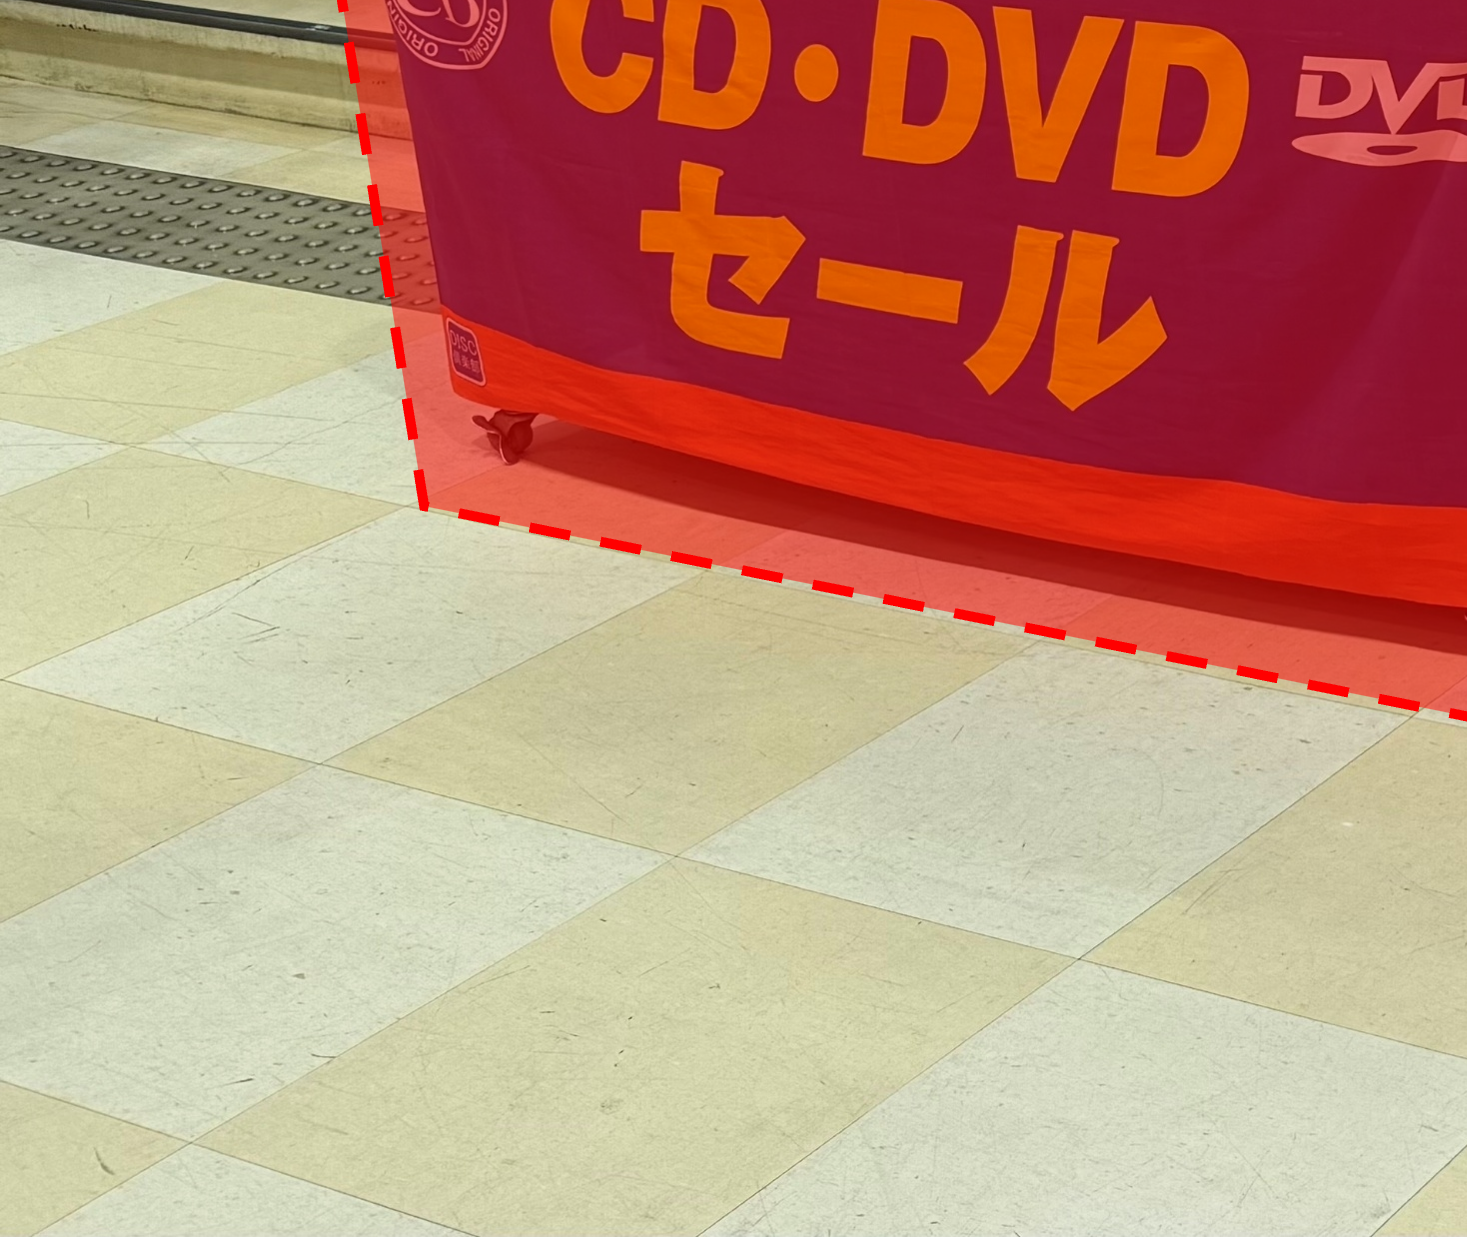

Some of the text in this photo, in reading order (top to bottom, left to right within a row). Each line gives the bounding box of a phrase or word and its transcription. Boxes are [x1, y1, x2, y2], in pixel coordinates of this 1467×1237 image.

[449, 329, 478, 356] DISC
[638, 160, 1169, 413] セール
